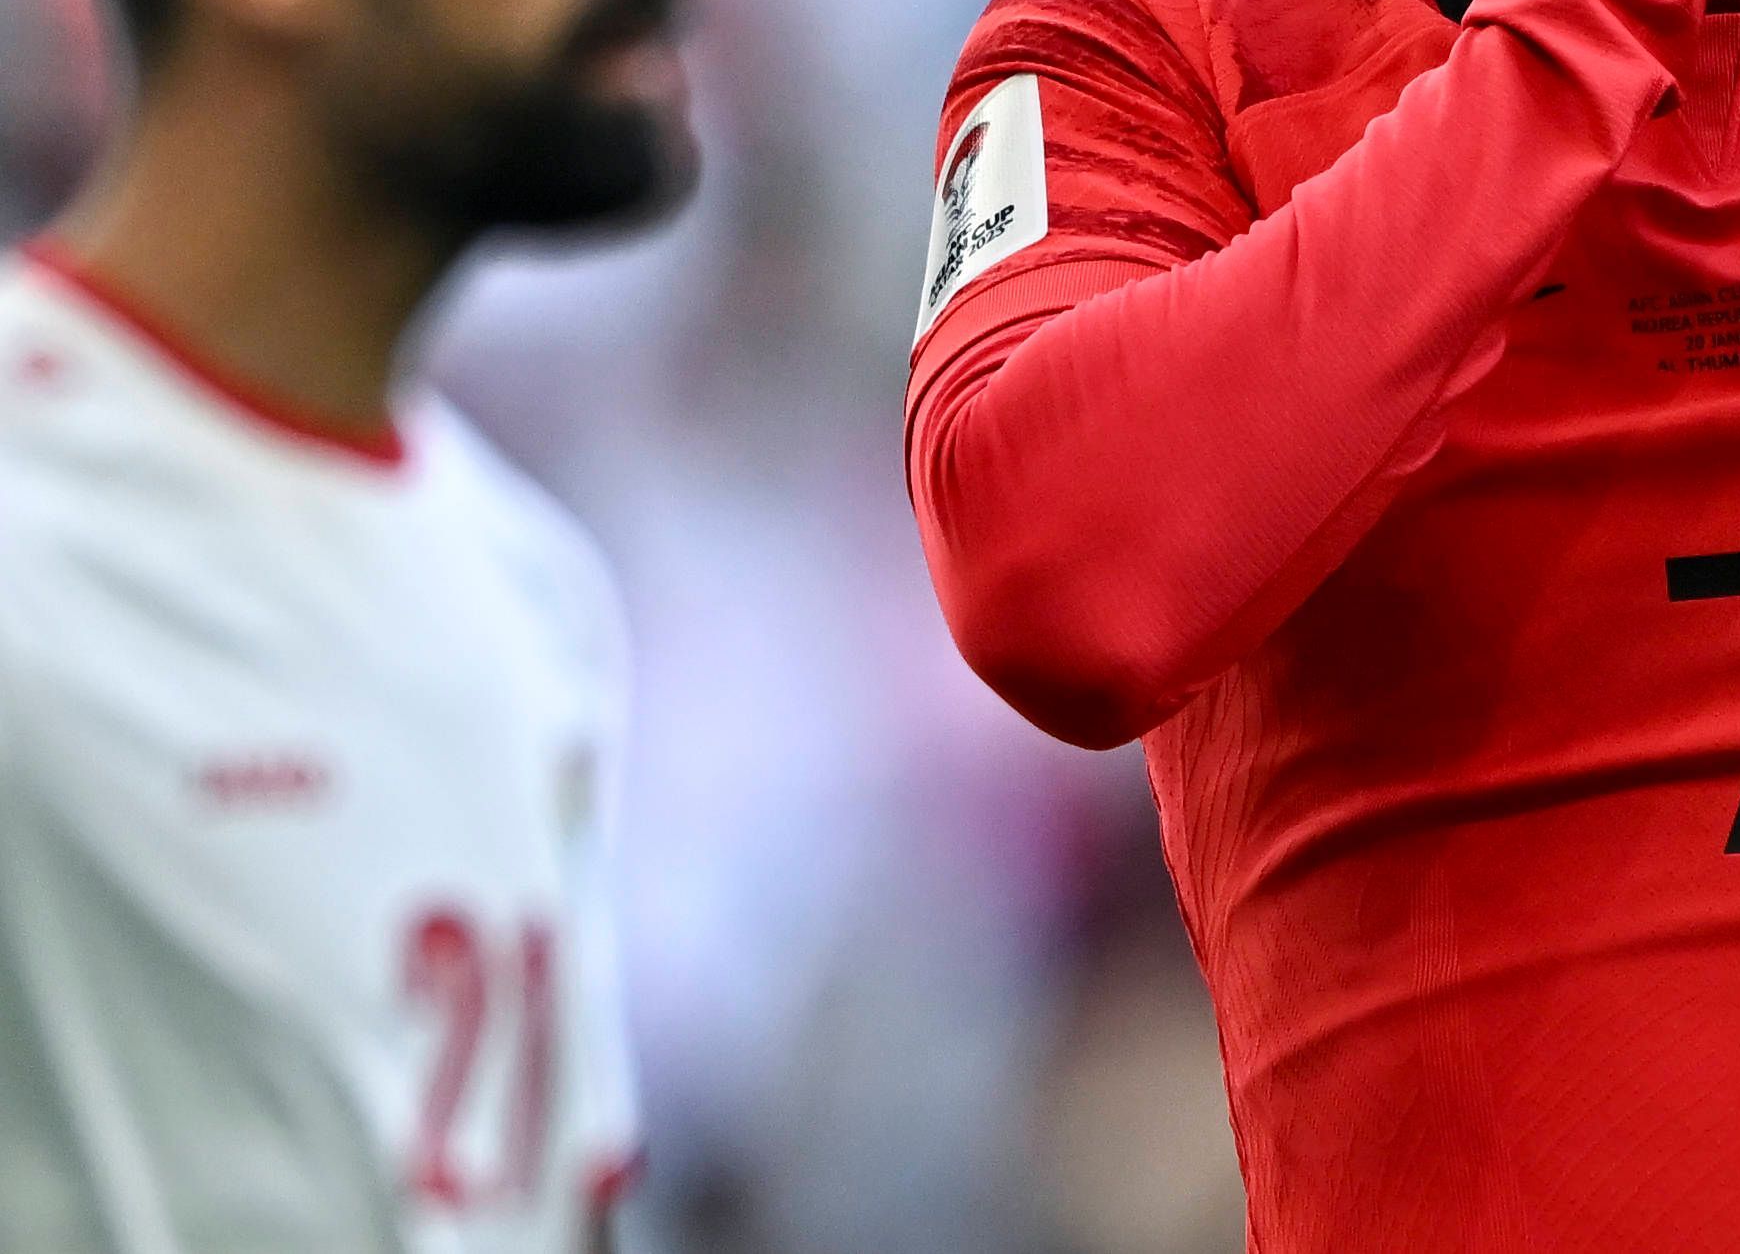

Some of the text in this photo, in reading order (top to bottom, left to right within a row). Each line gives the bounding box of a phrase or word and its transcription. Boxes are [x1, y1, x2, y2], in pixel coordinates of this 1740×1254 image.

[971, 204, 1015, 241] CUP
[1631, 314, 1693, 334] KOREA
[402, 901, 562, 1216] 21
